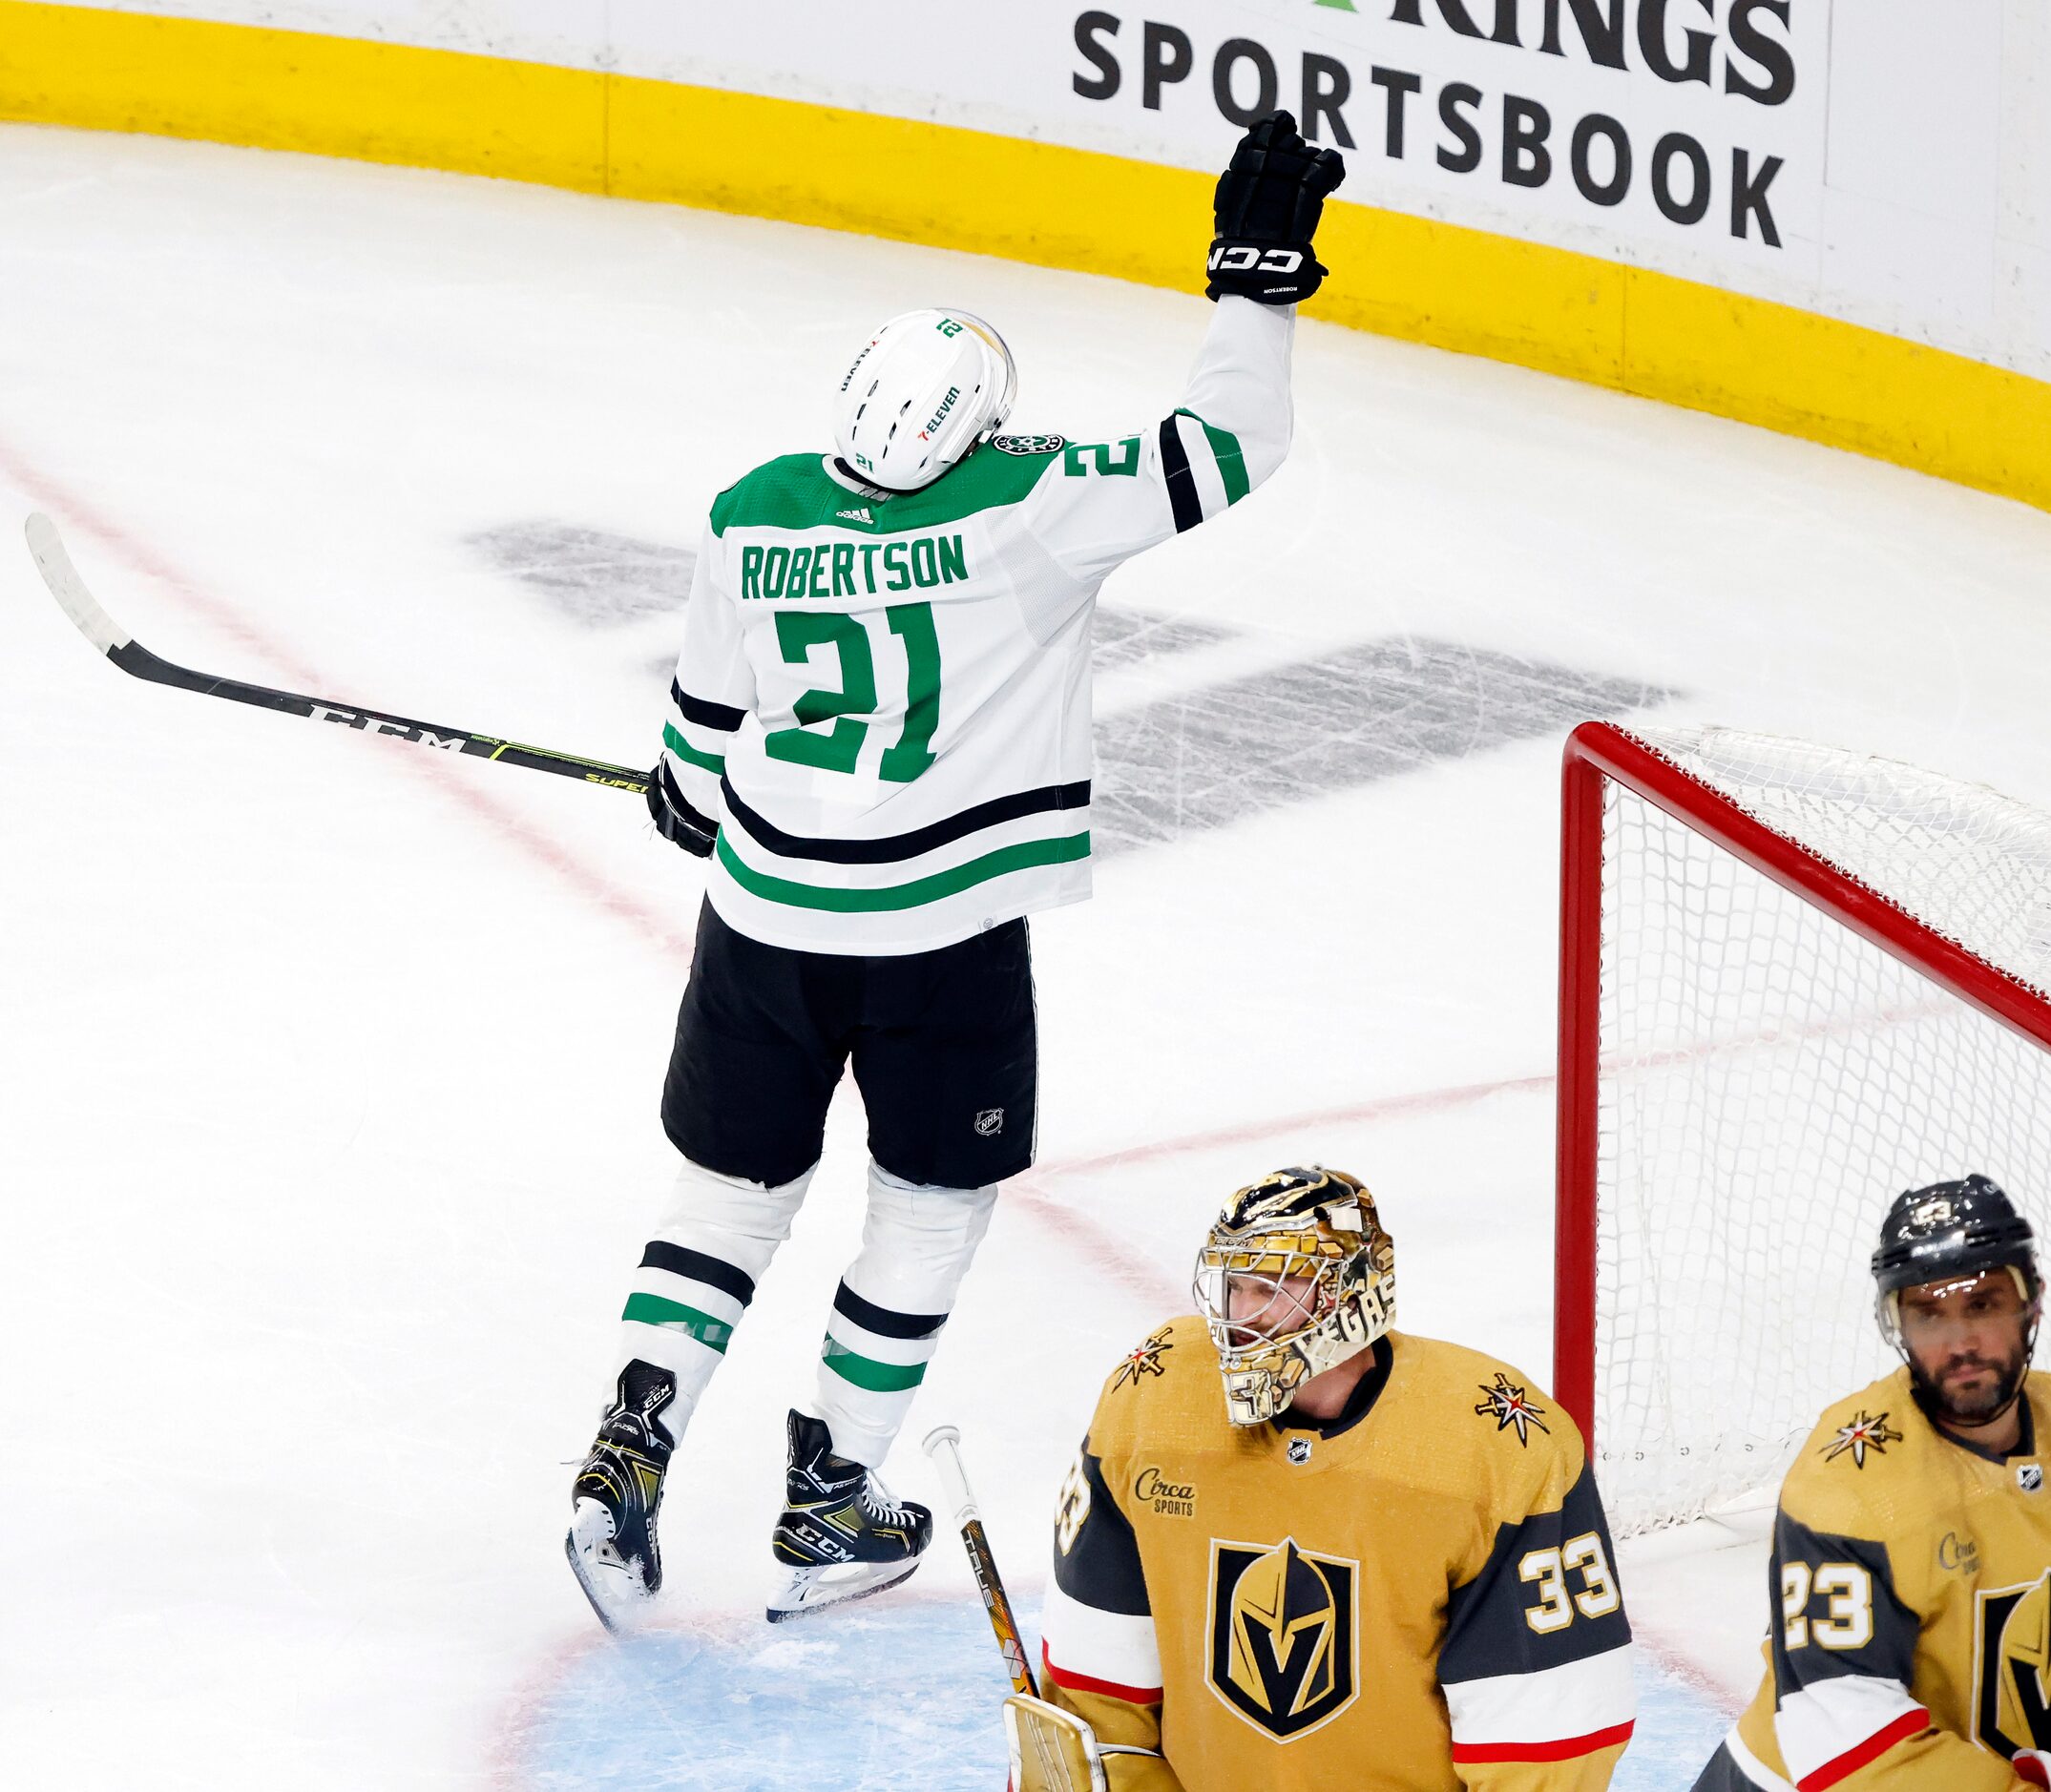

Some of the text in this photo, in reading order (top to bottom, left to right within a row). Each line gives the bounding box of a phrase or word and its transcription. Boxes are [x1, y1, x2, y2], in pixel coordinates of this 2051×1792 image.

[1073, 10, 1784, 248] SPORTSBOOK
[1263, 286, 1298, 295] ROBERTSON
[935, 318, 964, 339] 21
[855, 452, 874, 474] 21
[835, 511, 874, 524] adidas
[742, 534, 969, 599] ROBERTSON
[764, 601, 942, 783] 21
[643, 1385, 670, 1409] CCM
[1136, 1468, 1195, 1501] Circa
[1154, 1499, 1193, 1516] SPORTS
[796, 1524, 855, 1562] CCM
[965, 1531, 994, 1608] TRUE
[1518, 1531, 1620, 1635] 33
[1781, 1561, 1874, 1651] 23
